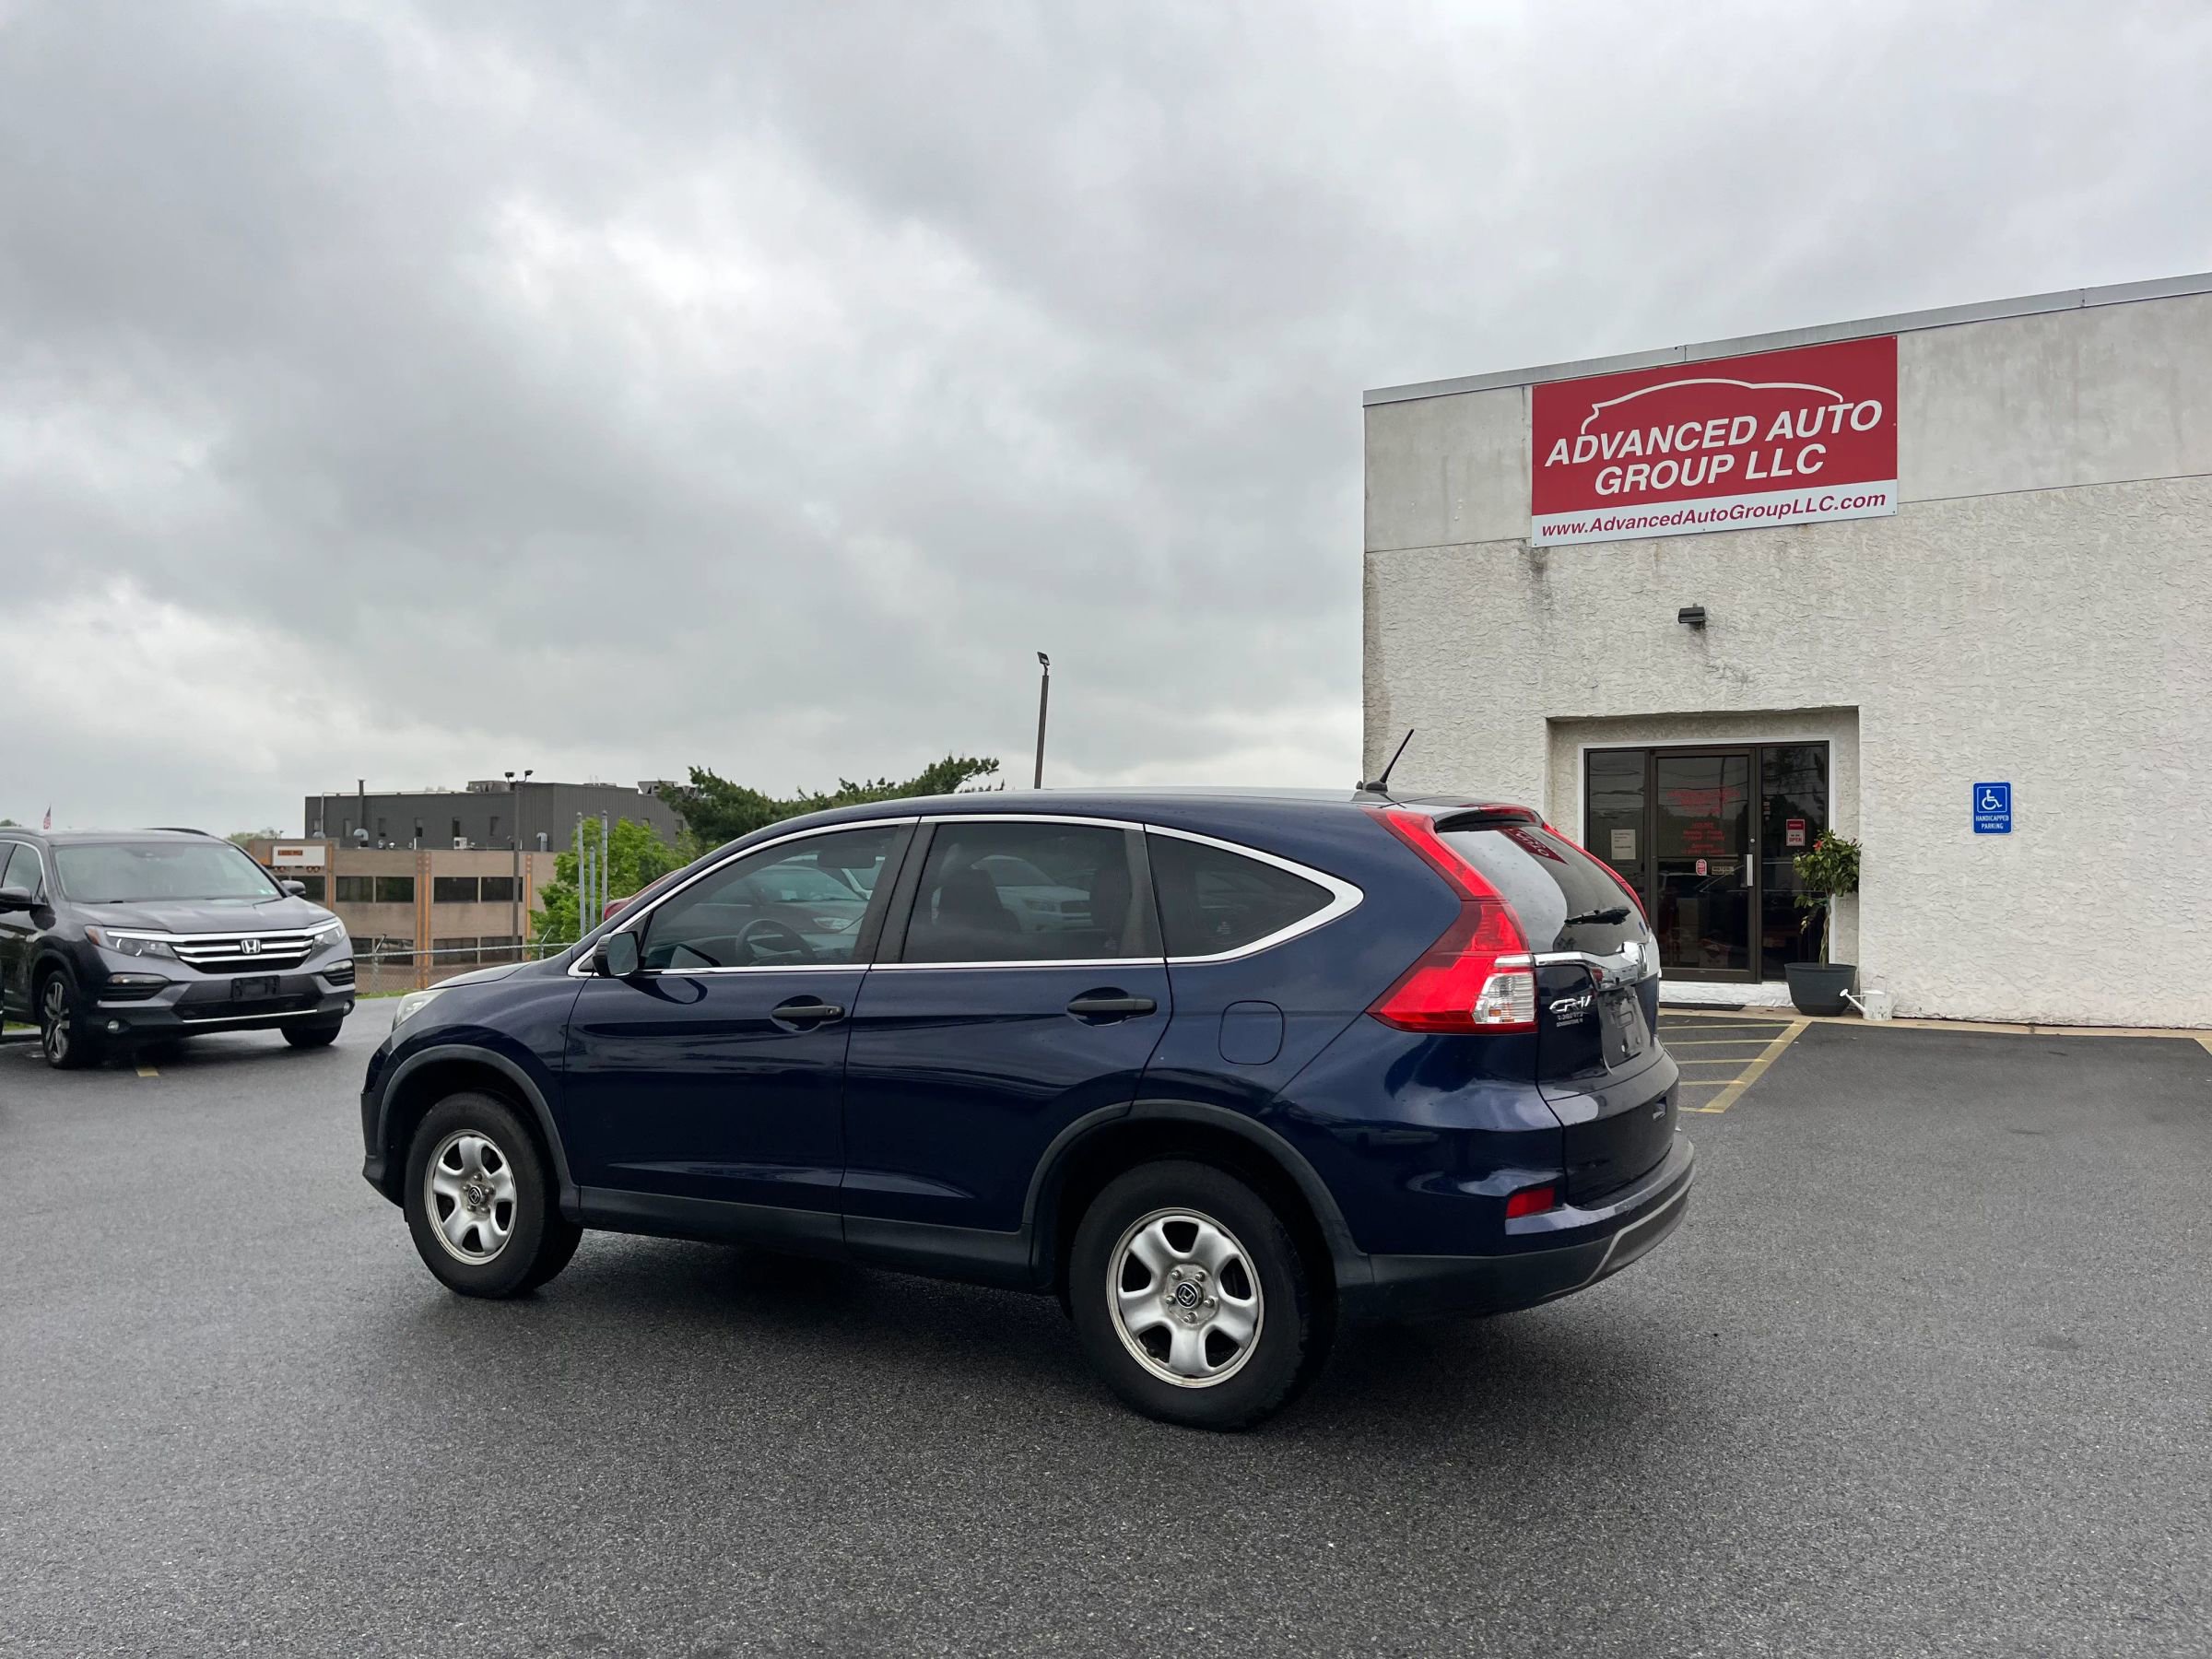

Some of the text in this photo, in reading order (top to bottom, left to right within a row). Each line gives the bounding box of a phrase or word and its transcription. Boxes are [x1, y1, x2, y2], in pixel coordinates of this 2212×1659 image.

[1545, 399, 1883, 467] ADVANCED AUTO
[1594, 442, 1827, 496] GROUP LLC
[1541, 492, 1887, 536] www.AdvancedAutoGroupLLC.com
